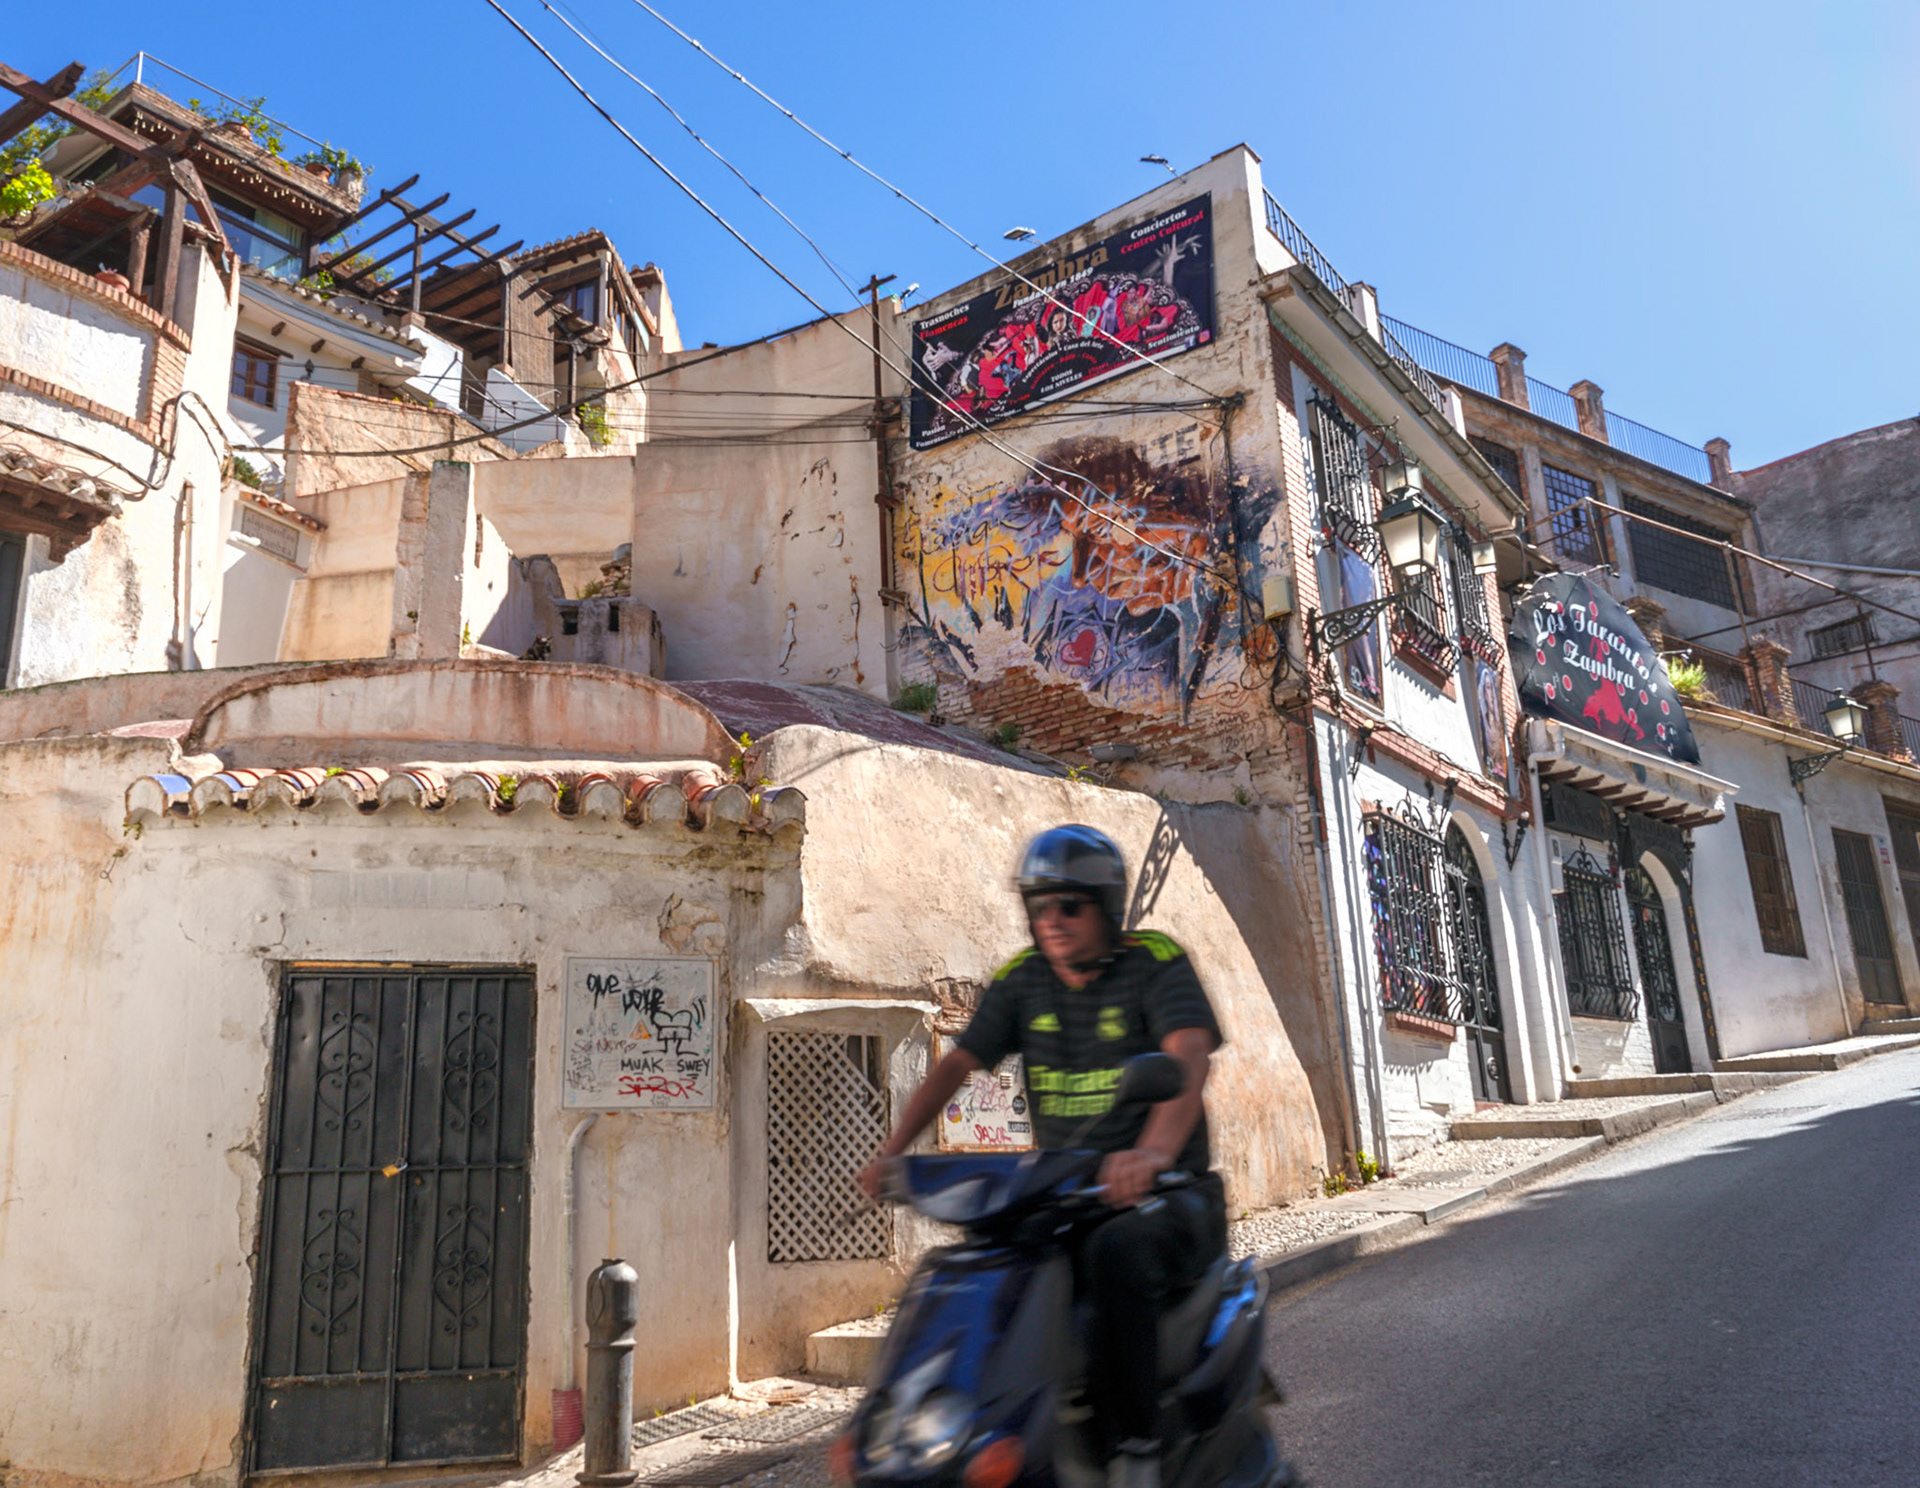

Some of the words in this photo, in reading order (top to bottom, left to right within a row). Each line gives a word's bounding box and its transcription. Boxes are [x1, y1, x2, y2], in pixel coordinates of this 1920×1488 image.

[1120, 234, 1157, 255] Centro
[1158, 209, 1205, 238] Cultural
[1130, 209, 1188, 240] Conciertos
[993, 246, 1109, 312] Zambra
[1055, 279, 1067, 290] en
[919, 303, 970, 330] Trasnoches
[919, 315, 969, 340] Flamencas
[1147, 325, 1201, 350] Sentimiento
[1040, 384, 1054, 394] LOS
[1054, 371, 1083, 389] NIVELES
[1050, 369, 1074, 383] TODOS
[1533, 608, 1567, 647] Los
[1569, 603, 1659, 697] Tarantos
[1562, 639, 1636, 690] Zambra
[620, 1057, 665, 1074] MUAK
